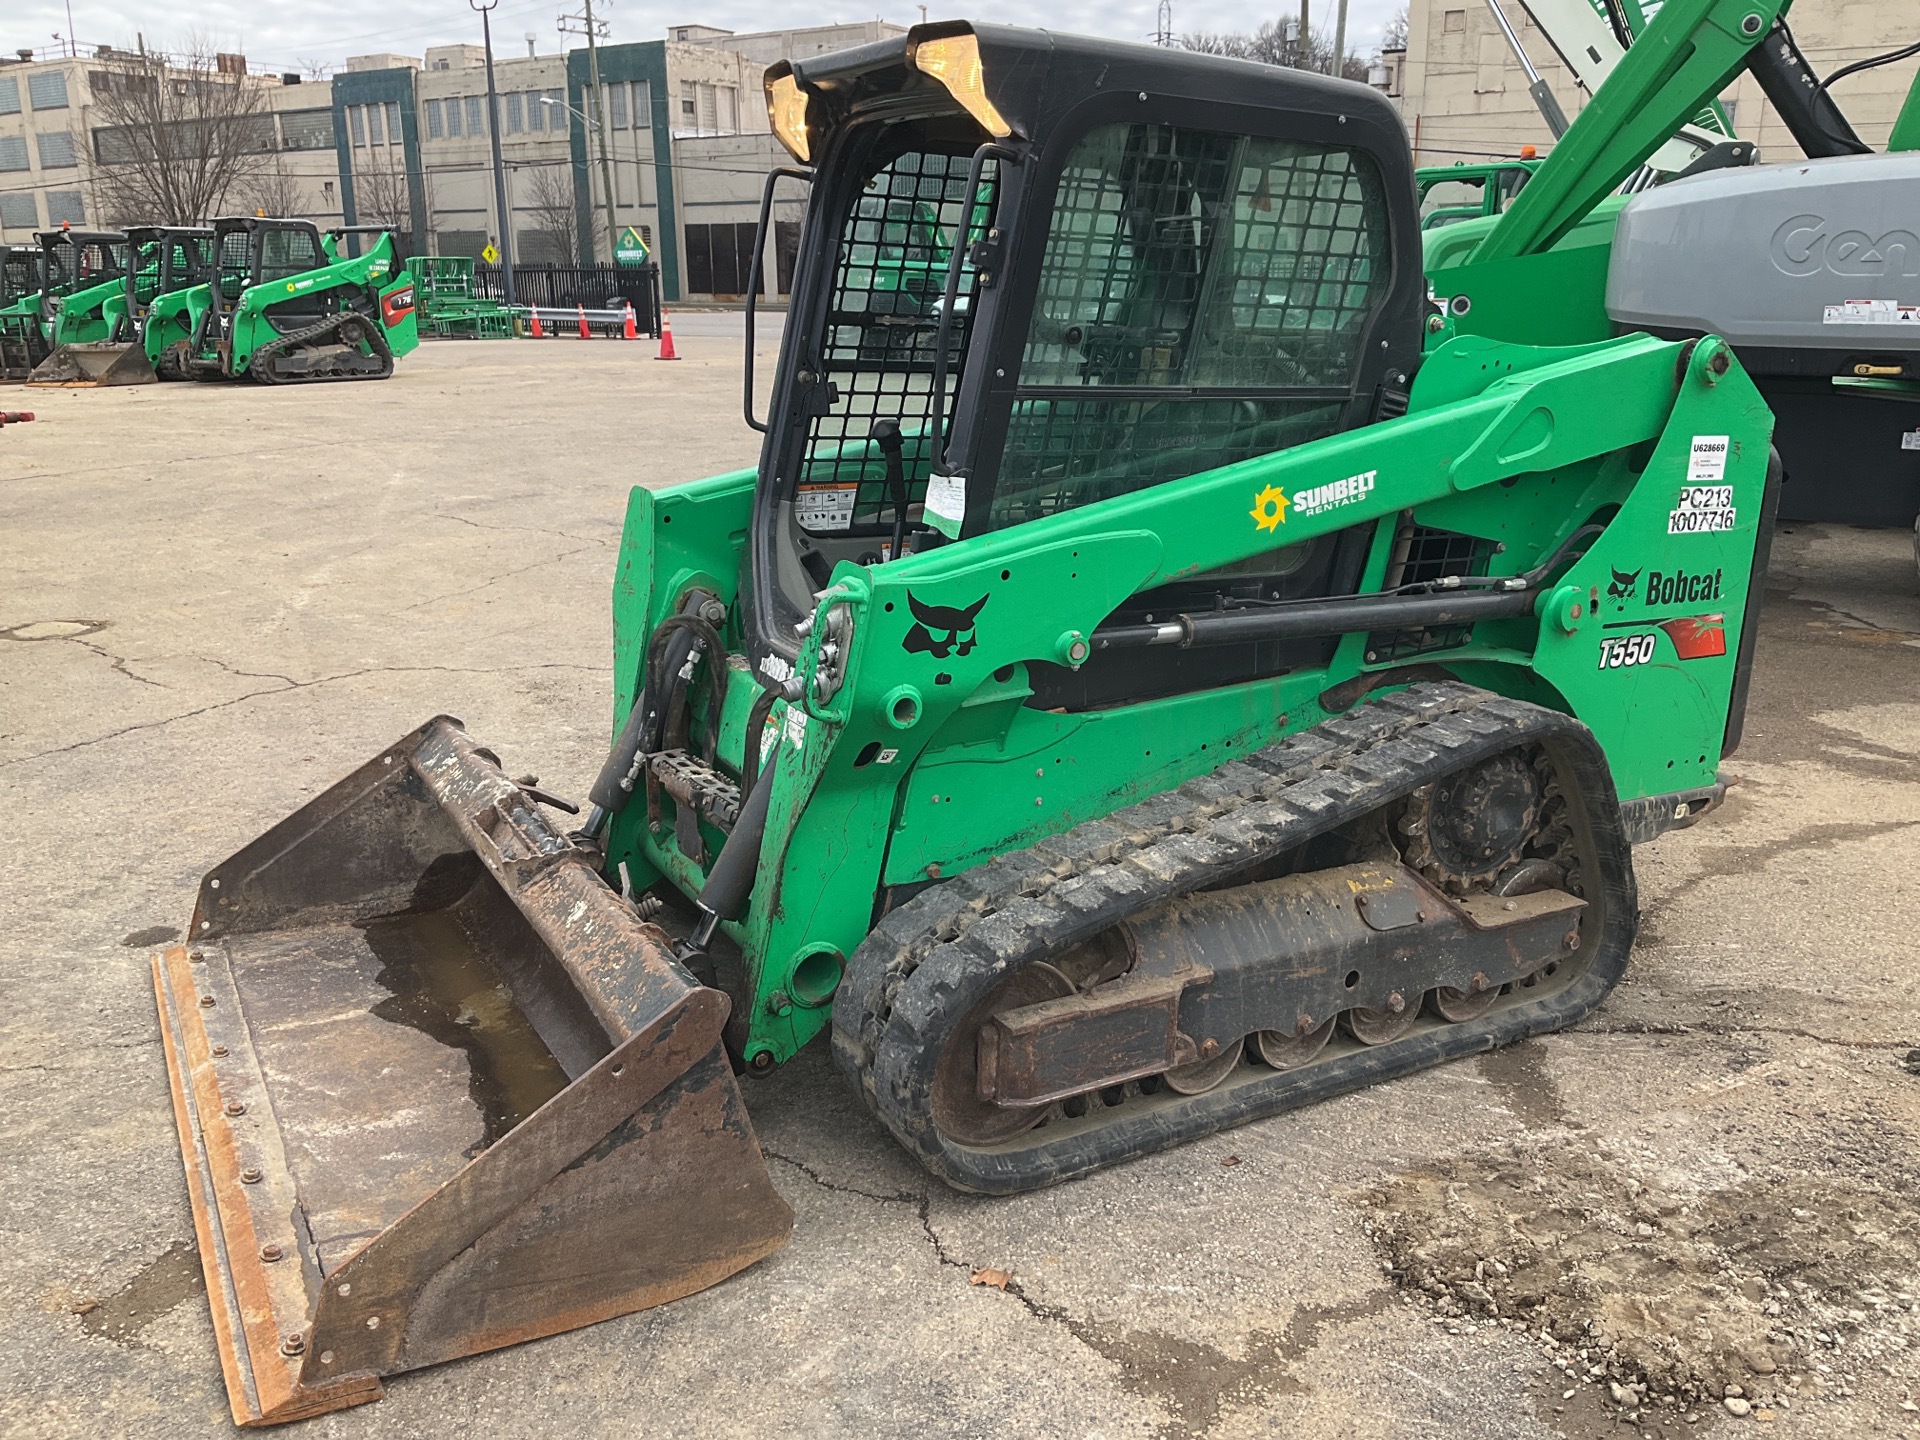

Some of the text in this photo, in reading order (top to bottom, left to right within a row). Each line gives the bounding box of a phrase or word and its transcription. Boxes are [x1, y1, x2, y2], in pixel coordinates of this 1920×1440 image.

[617, 250, 643, 258] SUNBELT
[1693, 443, 1726, 453] U628669
[1292, 469, 1377, 513] SUNBELT
[1677, 487, 1732, 509] PC213
[1305, 492, 1367, 517] RENTALS
[1669, 509, 1734, 532] 1007716
[1645, 568, 1722, 606] Bobcat
[1598, 633, 1657, 670] T550
